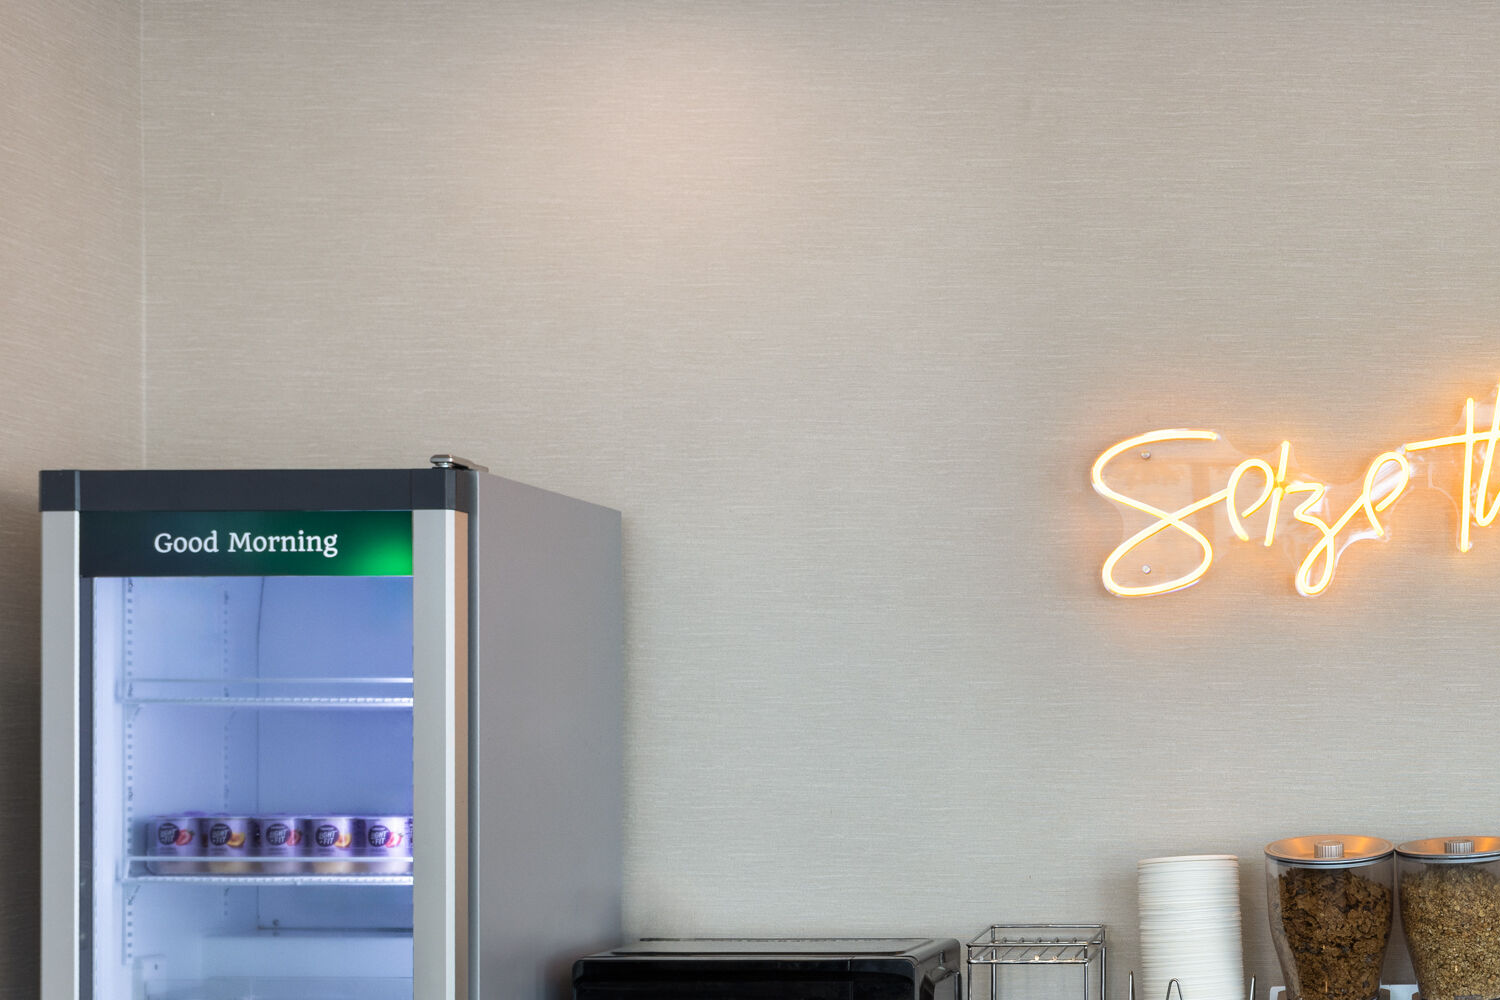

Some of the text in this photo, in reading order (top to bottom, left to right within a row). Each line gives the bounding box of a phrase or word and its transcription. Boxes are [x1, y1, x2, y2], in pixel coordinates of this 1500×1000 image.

[153, 529, 339, 559] Good Morning
[1091, 427, 1411, 597] Seize
